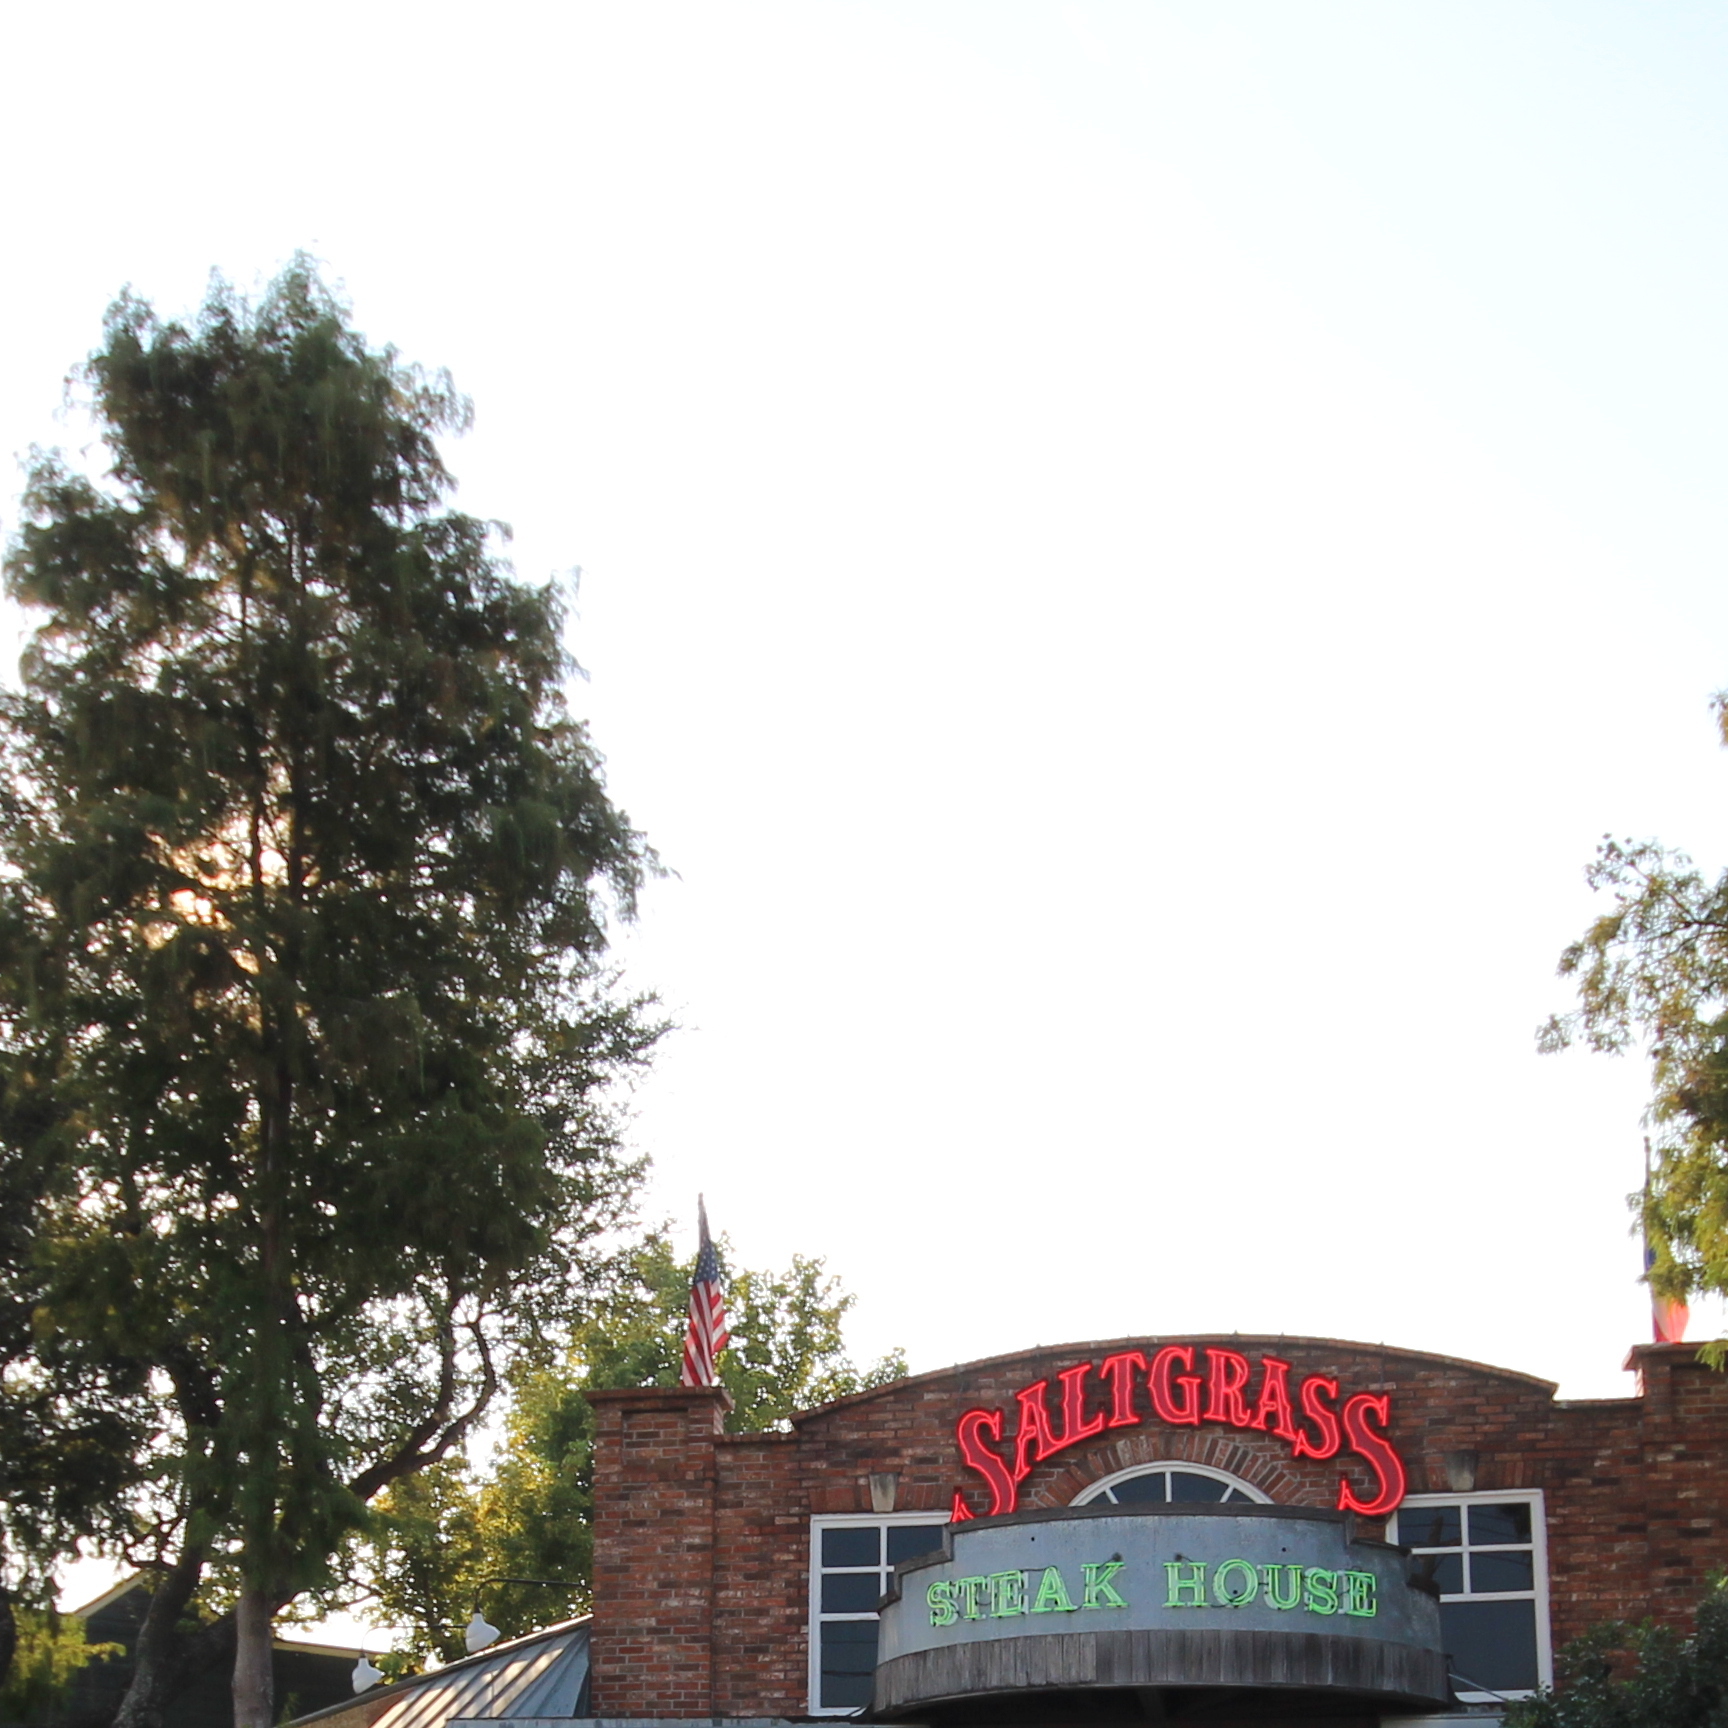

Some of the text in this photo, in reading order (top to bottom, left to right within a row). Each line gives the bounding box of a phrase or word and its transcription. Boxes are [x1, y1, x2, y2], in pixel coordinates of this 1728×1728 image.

[951, 1344, 1408, 1521] SALTGRASS
[926, 1558, 1378, 1627] STEAK HOUSE
